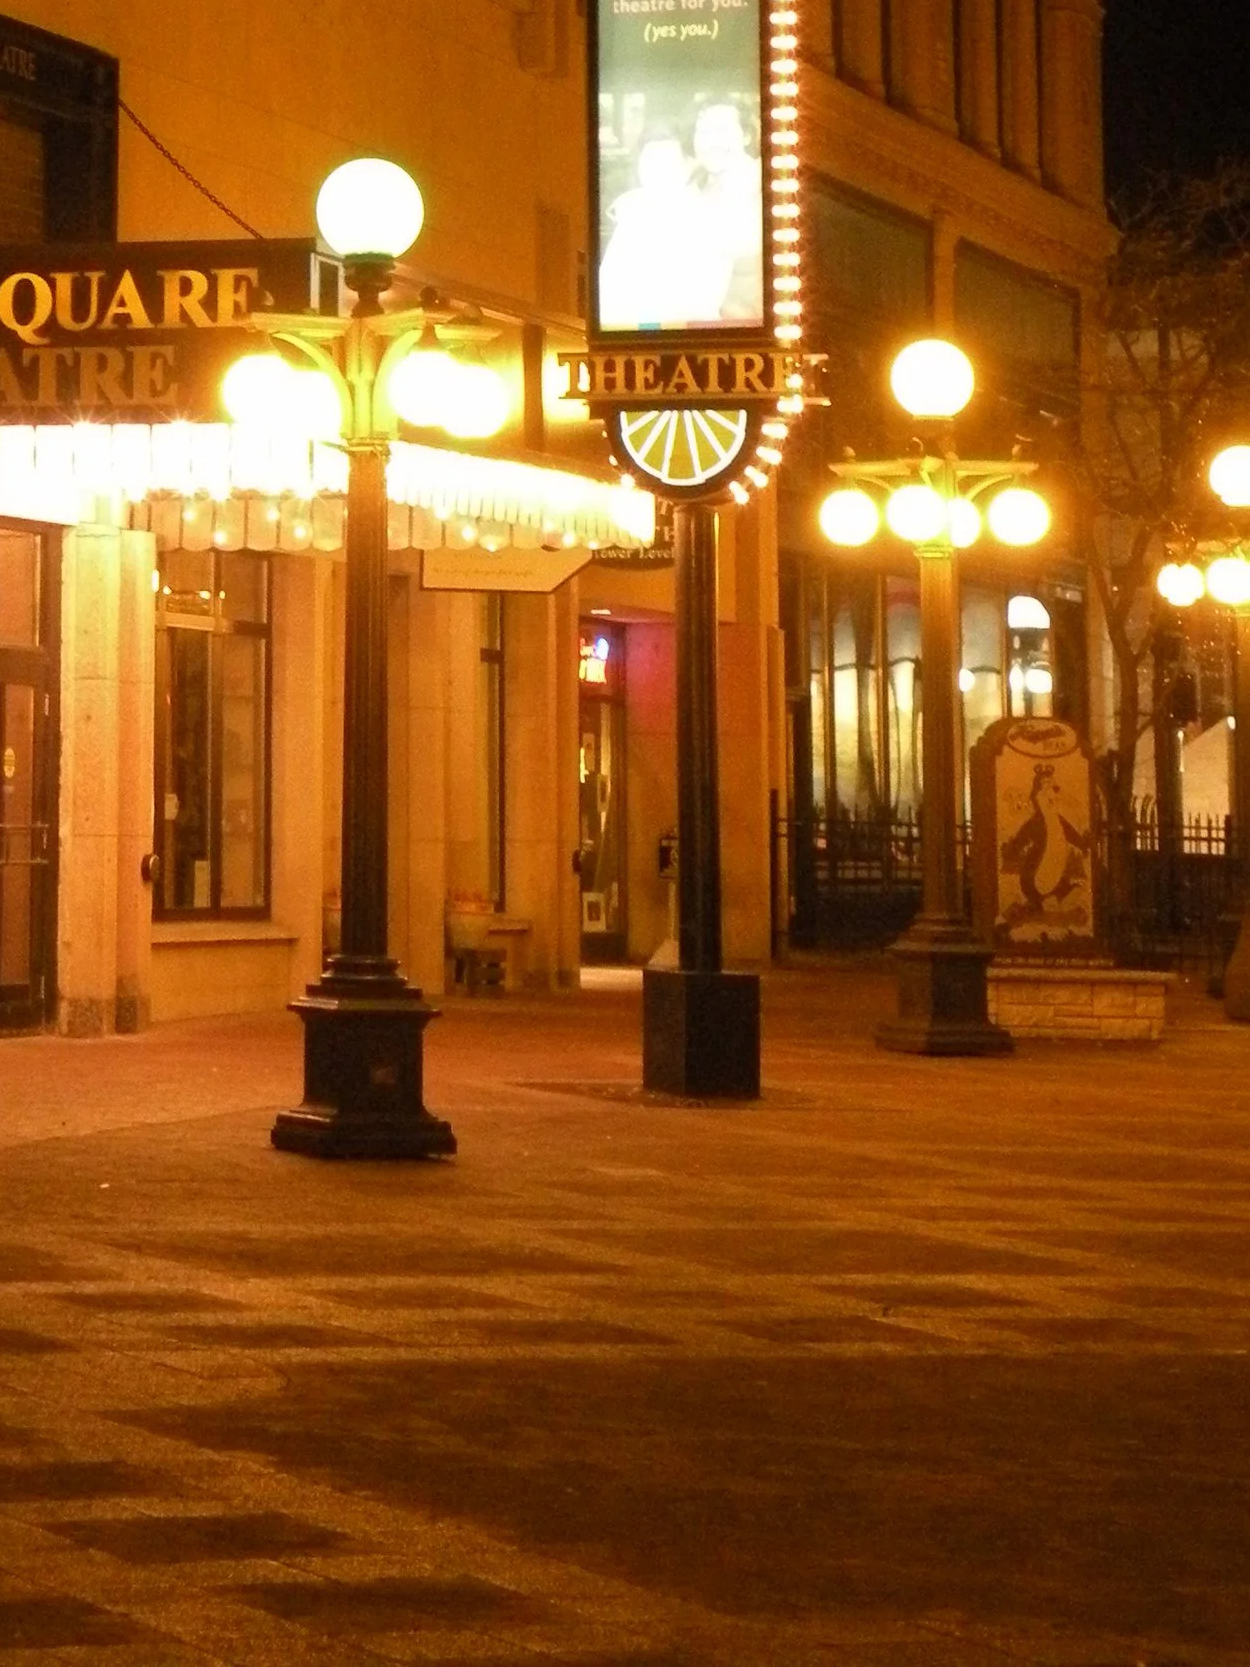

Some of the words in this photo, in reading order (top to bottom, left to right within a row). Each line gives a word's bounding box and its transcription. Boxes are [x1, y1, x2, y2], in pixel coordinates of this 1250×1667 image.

[643, 22, 677, 43] (yes
[680, 19, 719, 42] you.)
[557, 352, 800, 401] THEATRE
